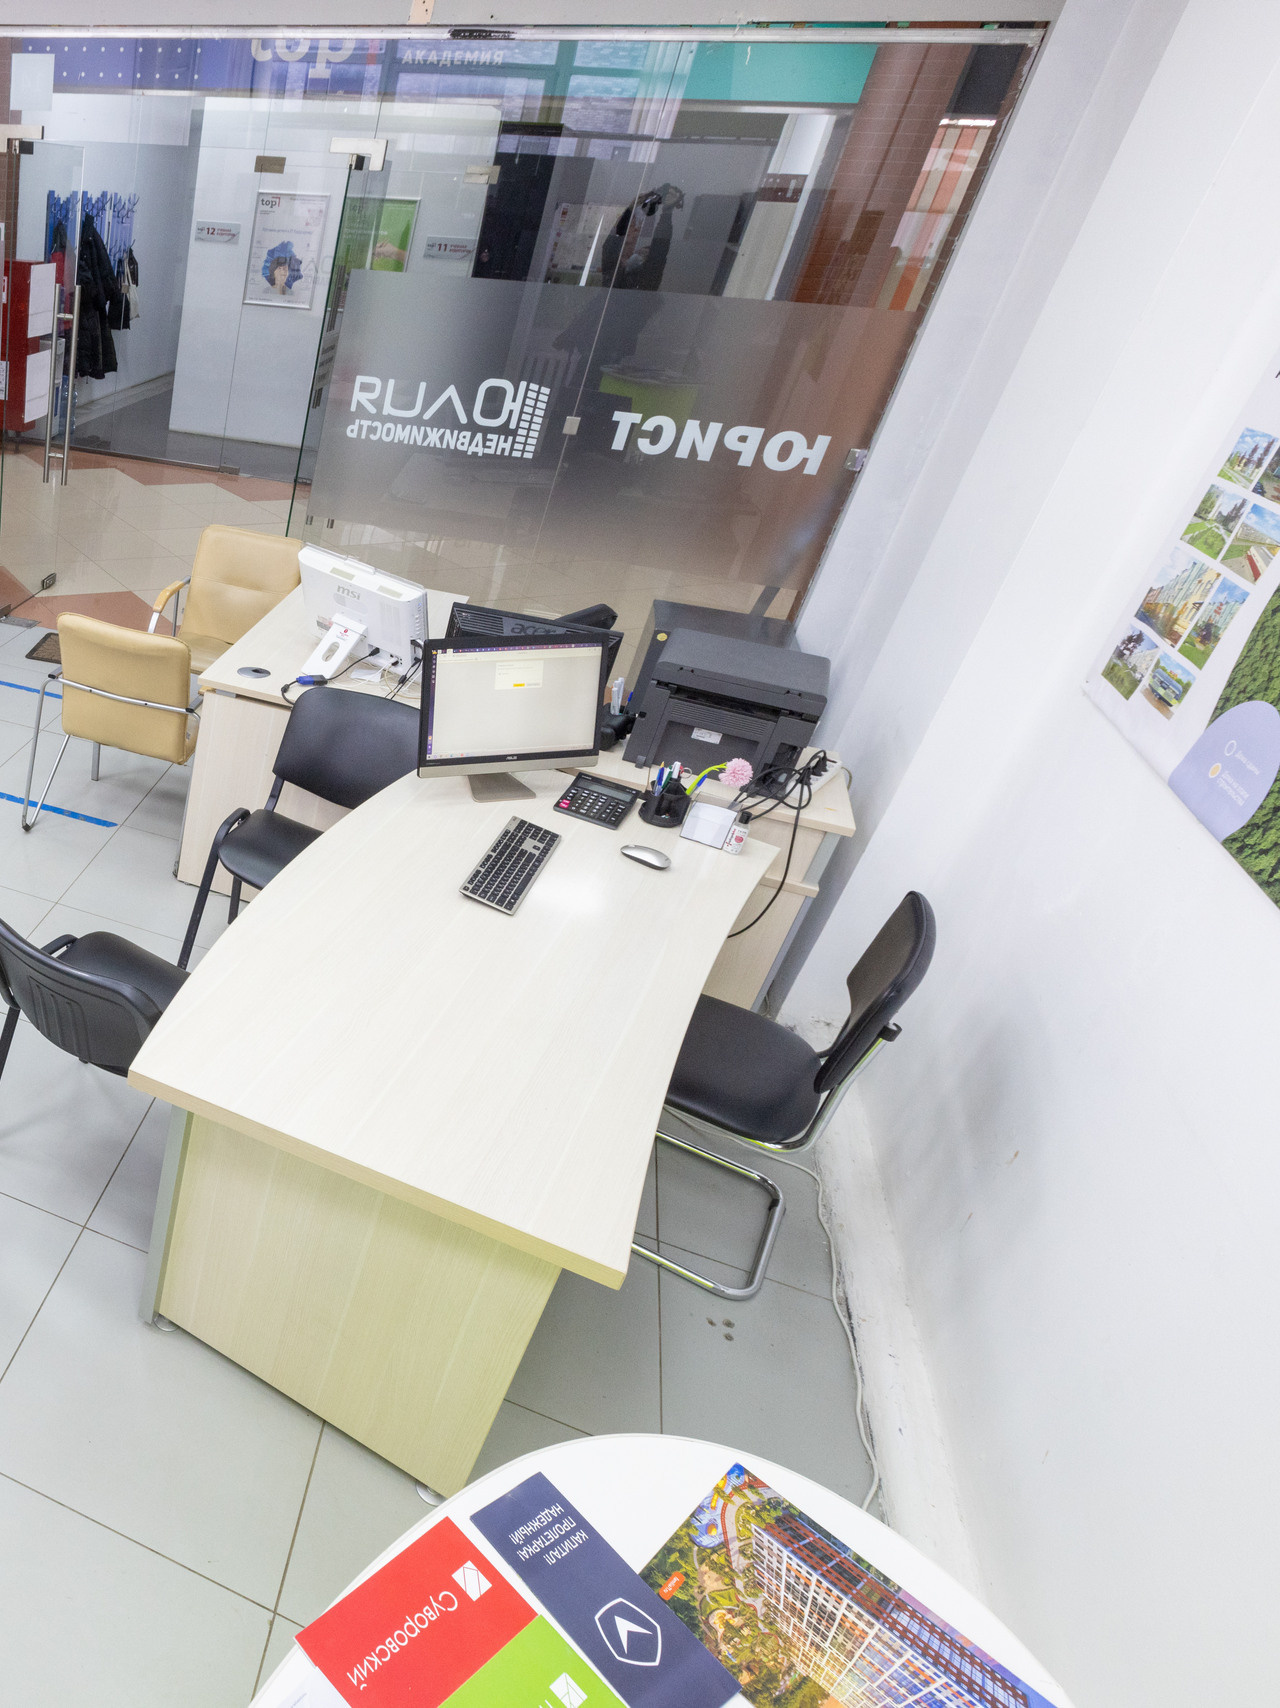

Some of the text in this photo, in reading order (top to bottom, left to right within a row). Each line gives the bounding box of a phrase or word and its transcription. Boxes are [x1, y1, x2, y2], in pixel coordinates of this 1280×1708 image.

[402, 50, 505, 67] АКАДЕМИЯ
[261, 197, 277, 208] top
[206, 227, 215, 236] 12
[437, 243, 448, 252] 11
[336, 584, 361, 601] msi
[507, 1502, 565, 1543] НАДЕЖНЫЙ!
[518, 1516, 577, 1562] ПРОЛЕТАРКА!
[545, 1529, 589, 1566] КАПИТАЛ!
[346, 1589, 458, 1691] Суворовский
